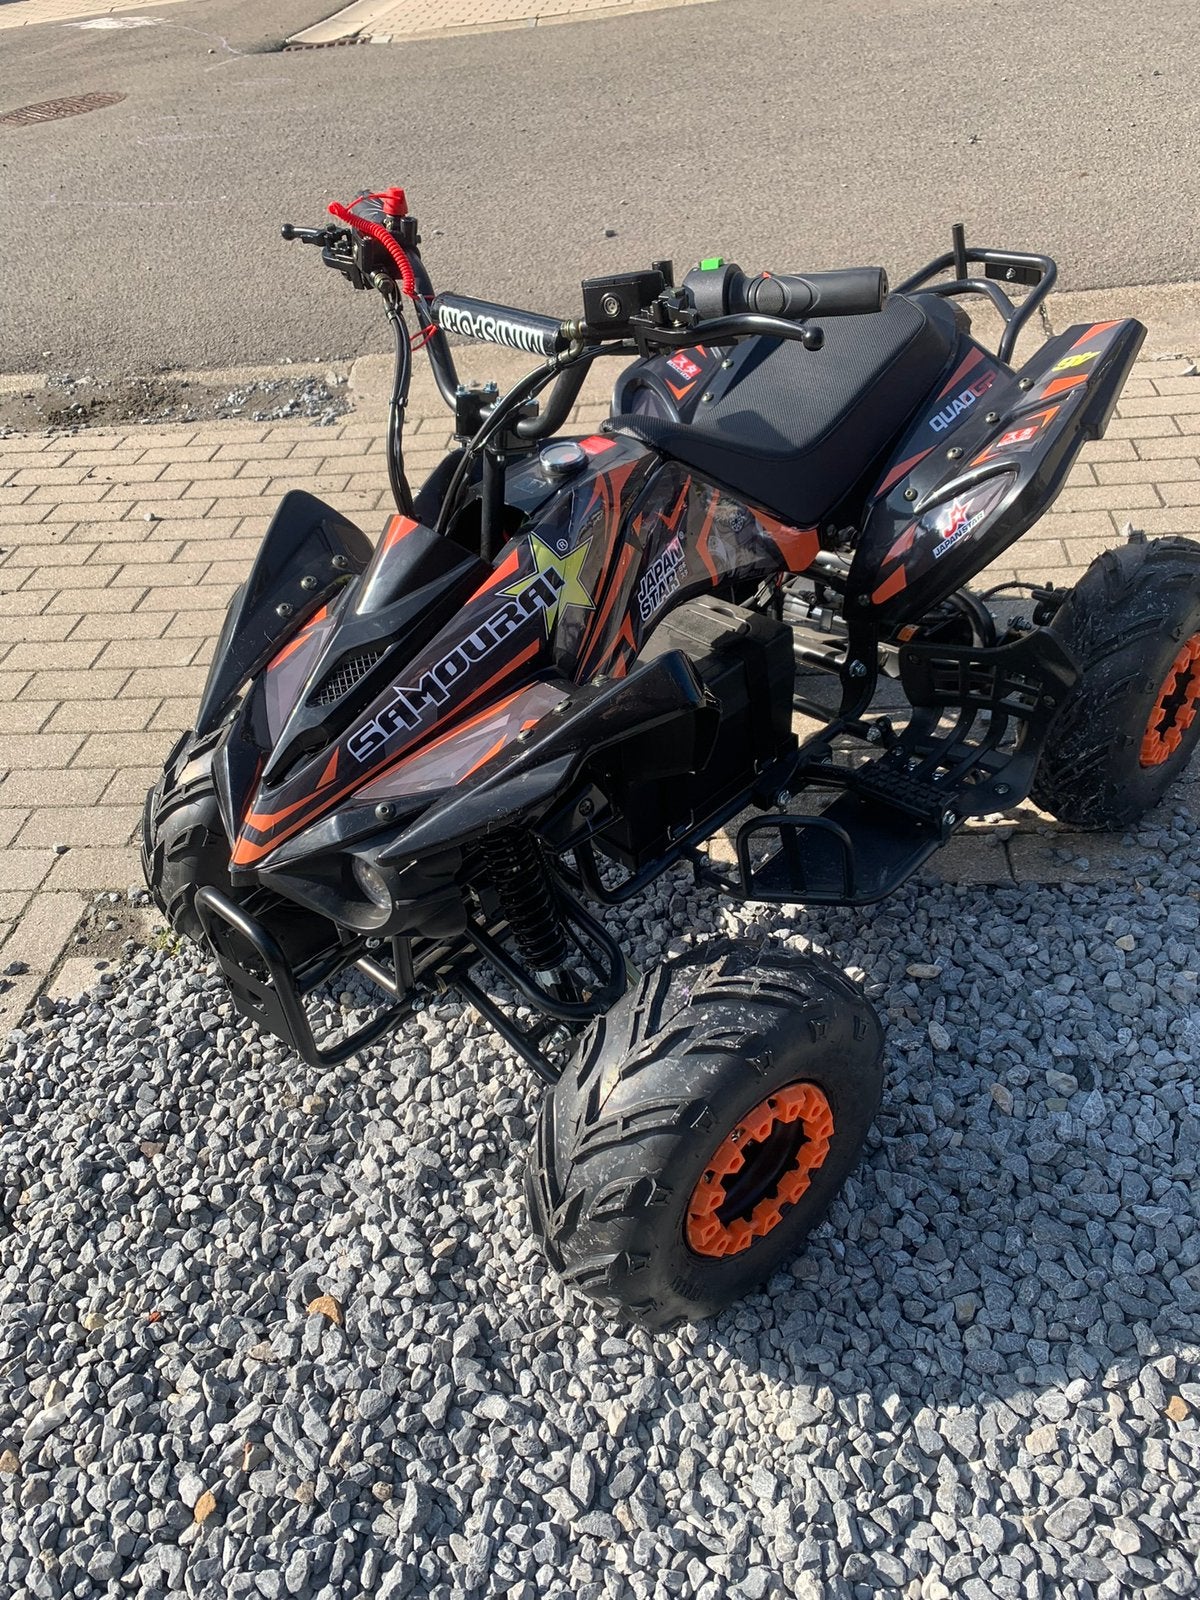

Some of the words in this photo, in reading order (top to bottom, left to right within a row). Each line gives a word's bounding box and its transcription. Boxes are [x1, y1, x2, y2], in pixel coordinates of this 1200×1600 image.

[438, 305, 547, 356] MINISPORT
[935, 511, 984, 557] JAPANSTAR
[638, 535, 684, 602] JAPAN
[639, 567, 682, 621] STAR
[347, 567, 565, 762] SAMOURAI
